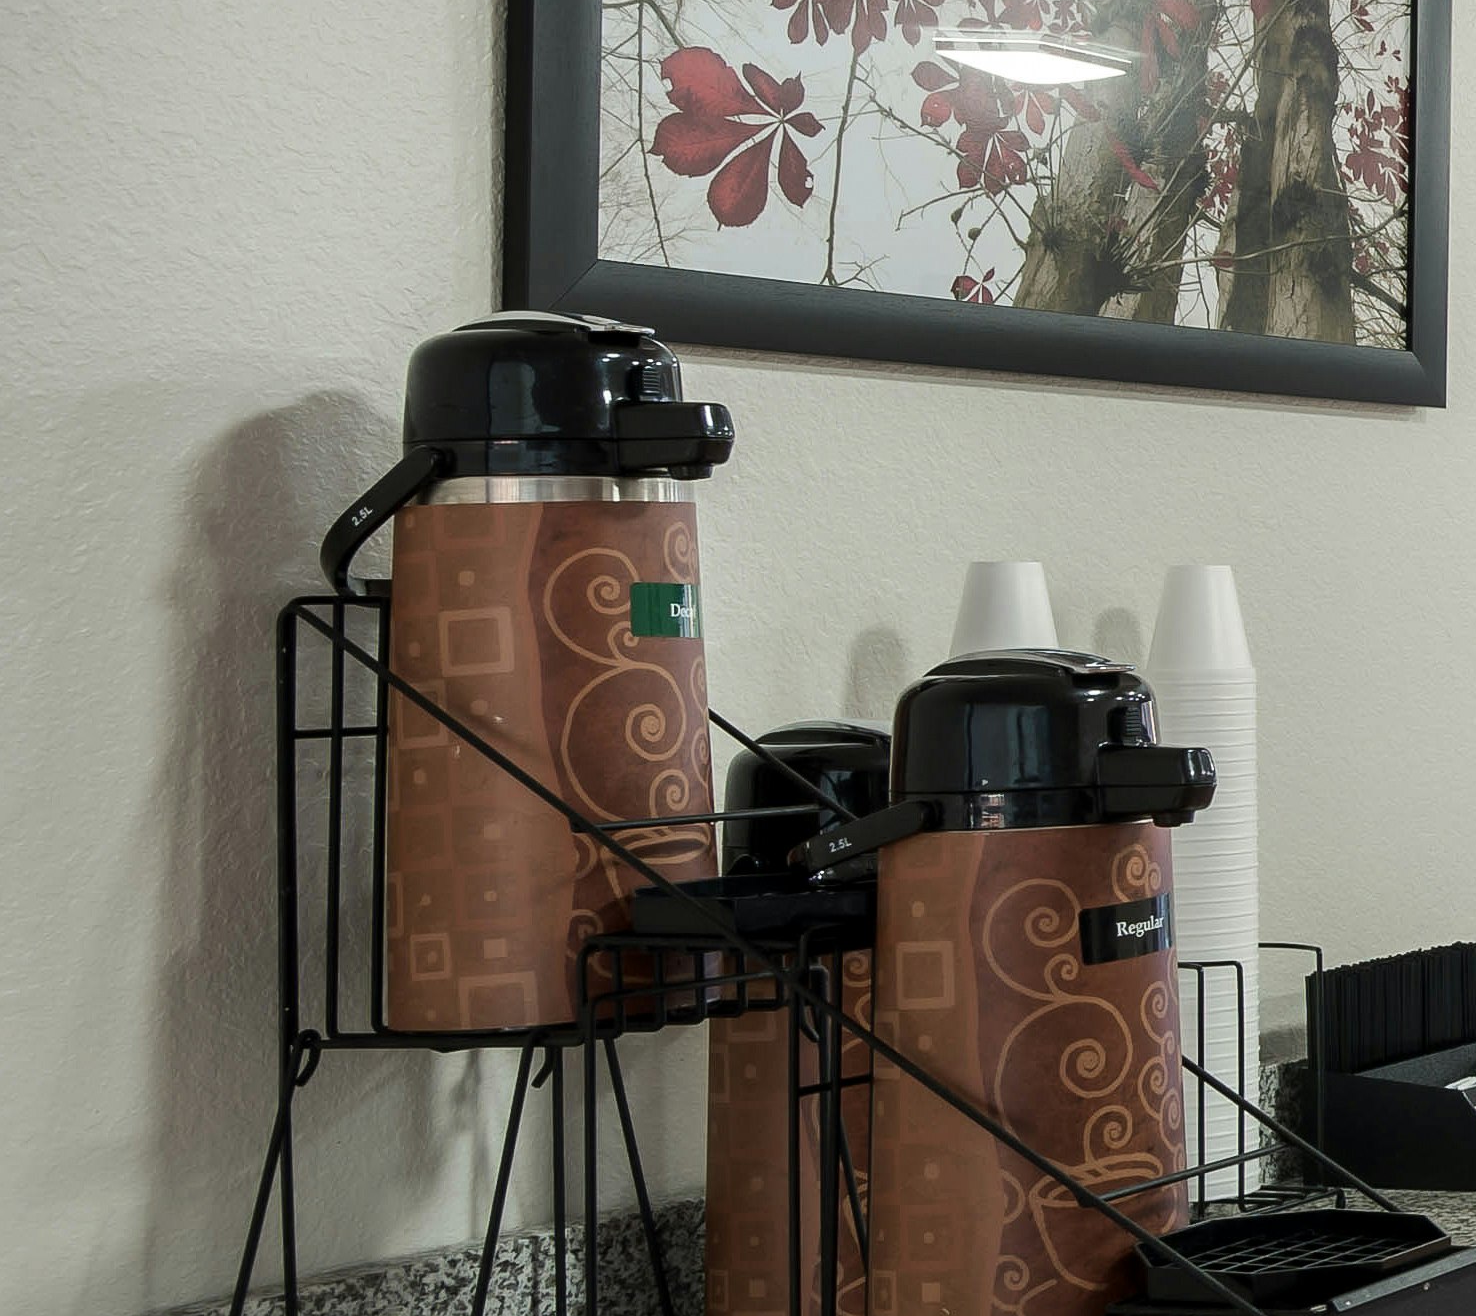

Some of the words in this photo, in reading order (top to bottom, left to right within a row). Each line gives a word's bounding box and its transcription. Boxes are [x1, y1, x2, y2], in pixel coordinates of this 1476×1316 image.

[351, 506, 374, 526] 2.5L
[829, 837, 852, 853] 2.5L
[1116, 915, 1164, 938] Regular
